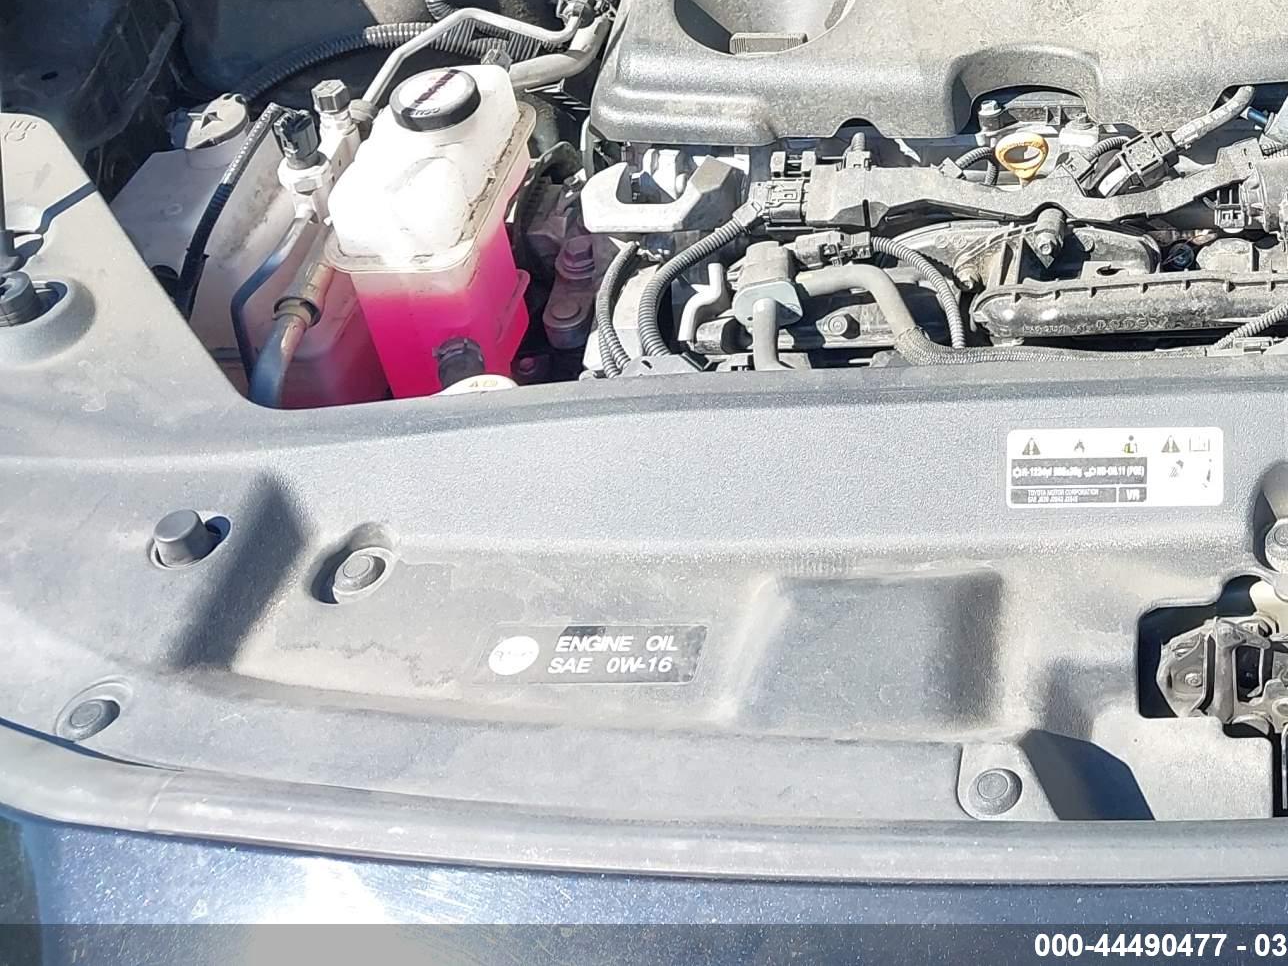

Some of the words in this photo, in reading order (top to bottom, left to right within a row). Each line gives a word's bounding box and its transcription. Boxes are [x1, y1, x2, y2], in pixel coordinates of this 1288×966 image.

[555, 636, 633, 652] ENGINE
[645, 636, 679, 651] OIL
[547, 658, 593, 674] SAE
[606, 657, 673, 674] 0W-16
